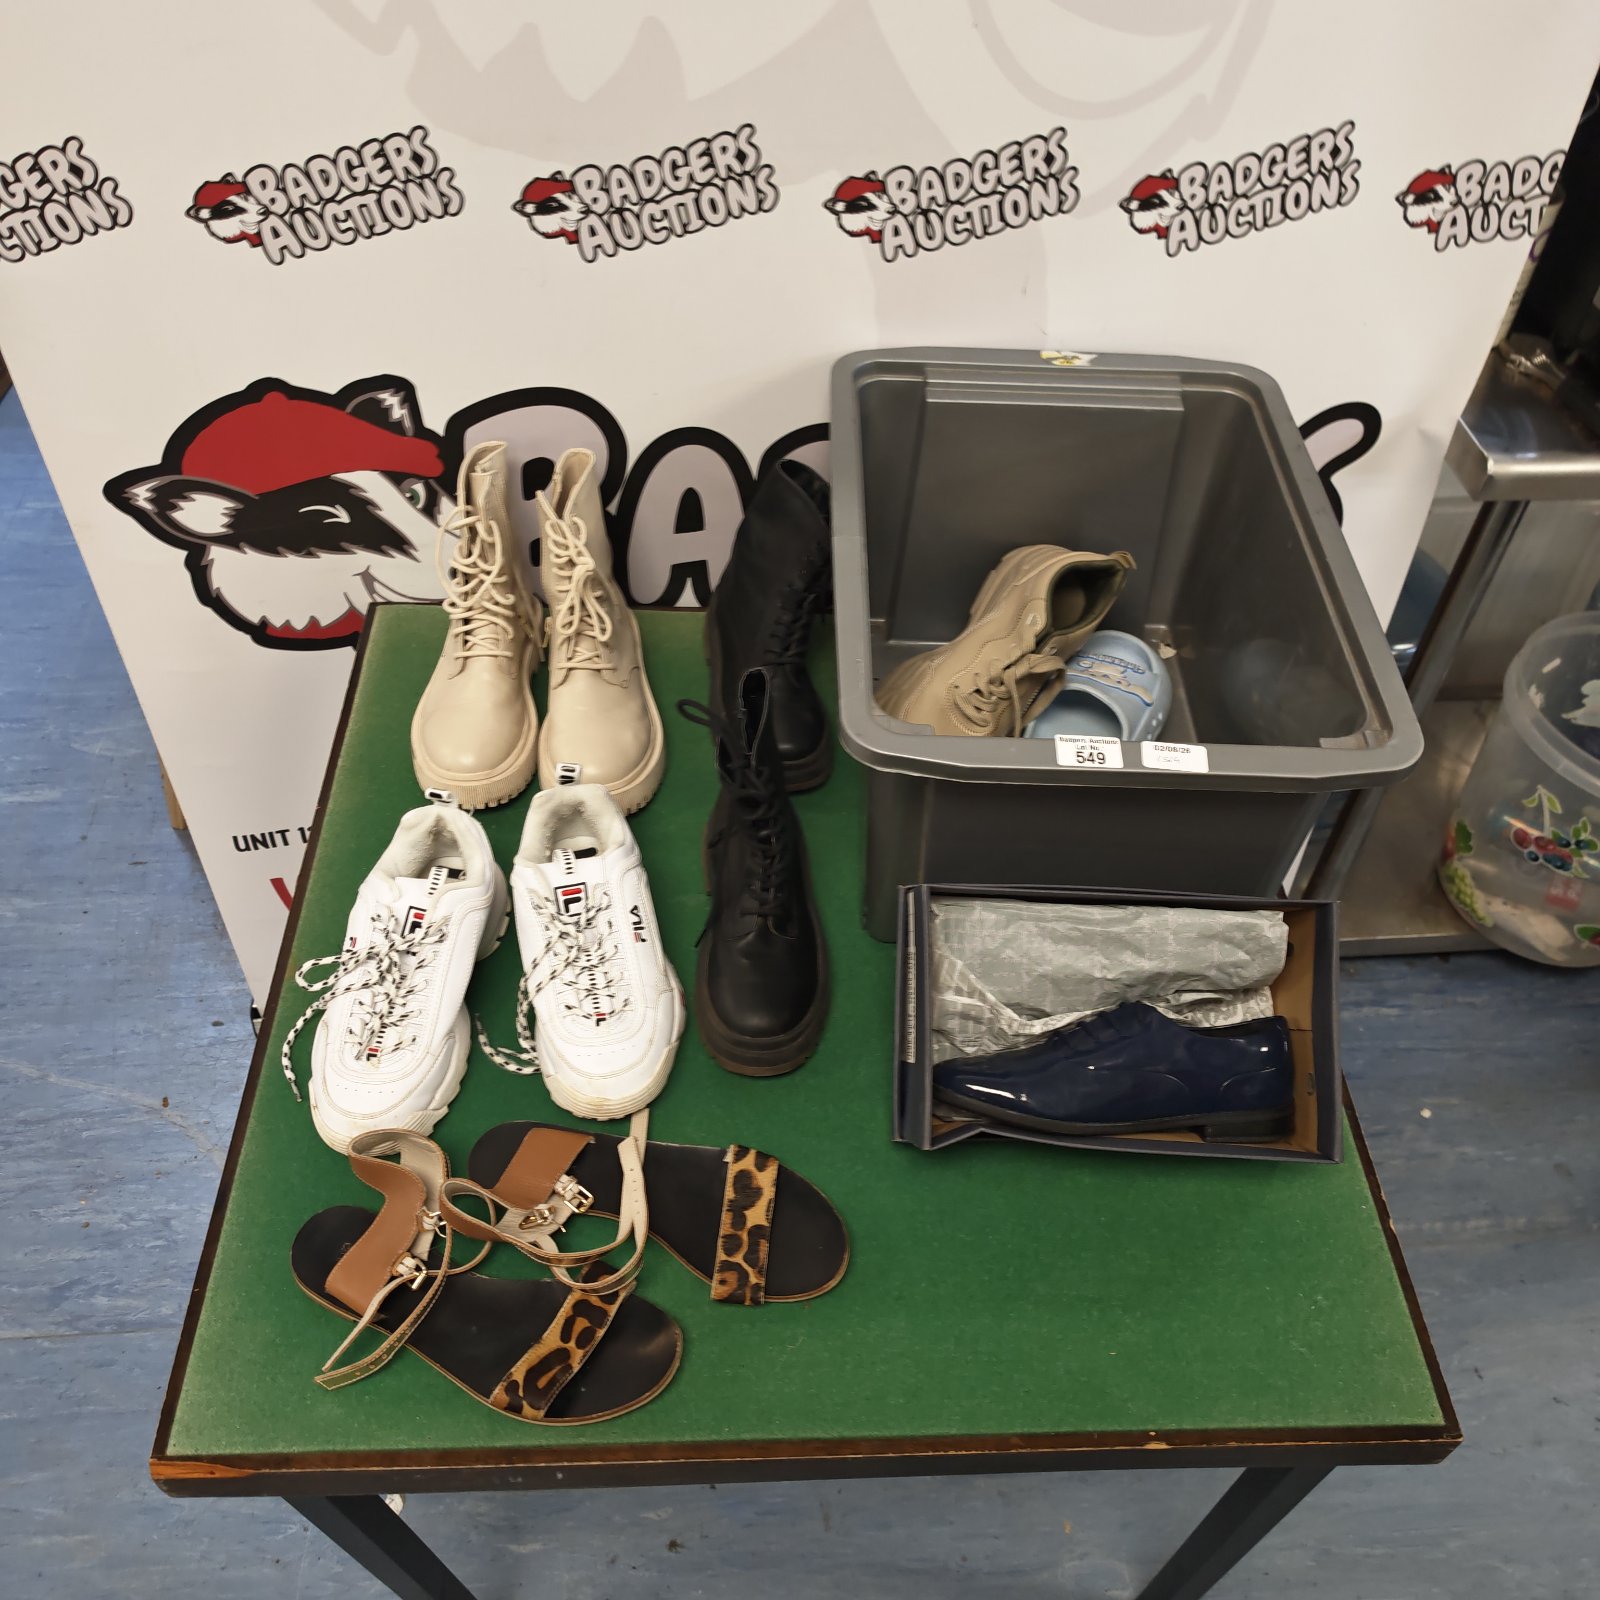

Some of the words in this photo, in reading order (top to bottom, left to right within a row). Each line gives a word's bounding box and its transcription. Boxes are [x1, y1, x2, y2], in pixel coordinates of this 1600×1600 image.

[243, 125, 438, 217] BADGERS
[572, 123, 761, 215] BADGERS
[885, 126, 1069, 216] BADGERS
[1166, 159, 1361, 258] AUCTIONS
[1178, 120, 1355, 211] BADGERS
[260, 167, 466, 265] AUCTIONS
[578, 164, 780, 263] AUCTIONS
[881, 166, 1080, 263] AUCTIONS
[1076, 750, 1106, 765] 549
[232, 829, 290, 852] UNIT
[629, 904, 647, 943] FILA
